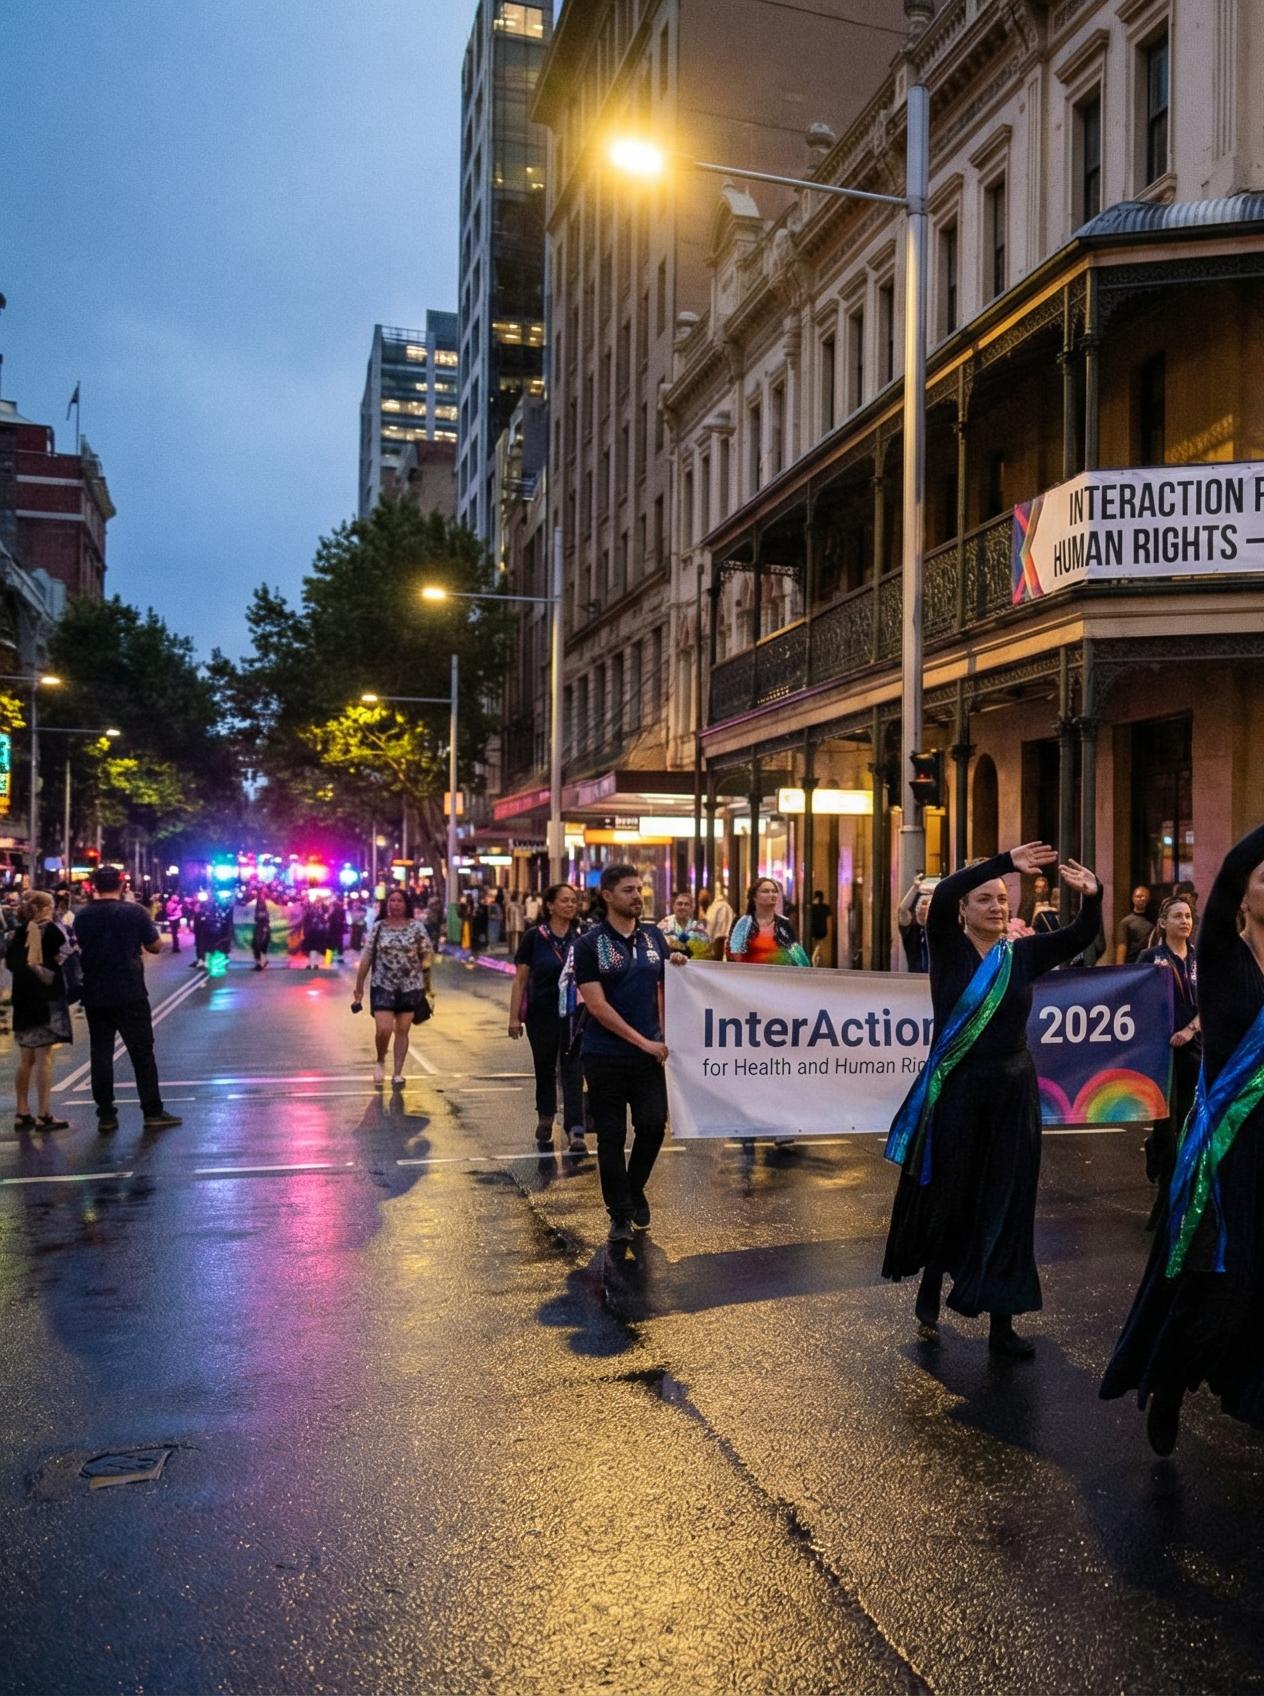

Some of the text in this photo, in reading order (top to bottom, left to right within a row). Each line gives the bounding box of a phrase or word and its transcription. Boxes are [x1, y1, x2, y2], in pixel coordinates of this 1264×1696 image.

[1069, 476, 1244, 526] INTERACTION
[1053, 529, 1123, 578] HUMAN
[1133, 523, 1238, 565] RIGHTS
[1039, 1004, 1136, 1044] 2026
[702, 1058, 728, 1076] for
[734, 1057, 791, 1076] Health
[797, 1057, 829, 1075] and
[835, 1057, 896, 1075] Human
